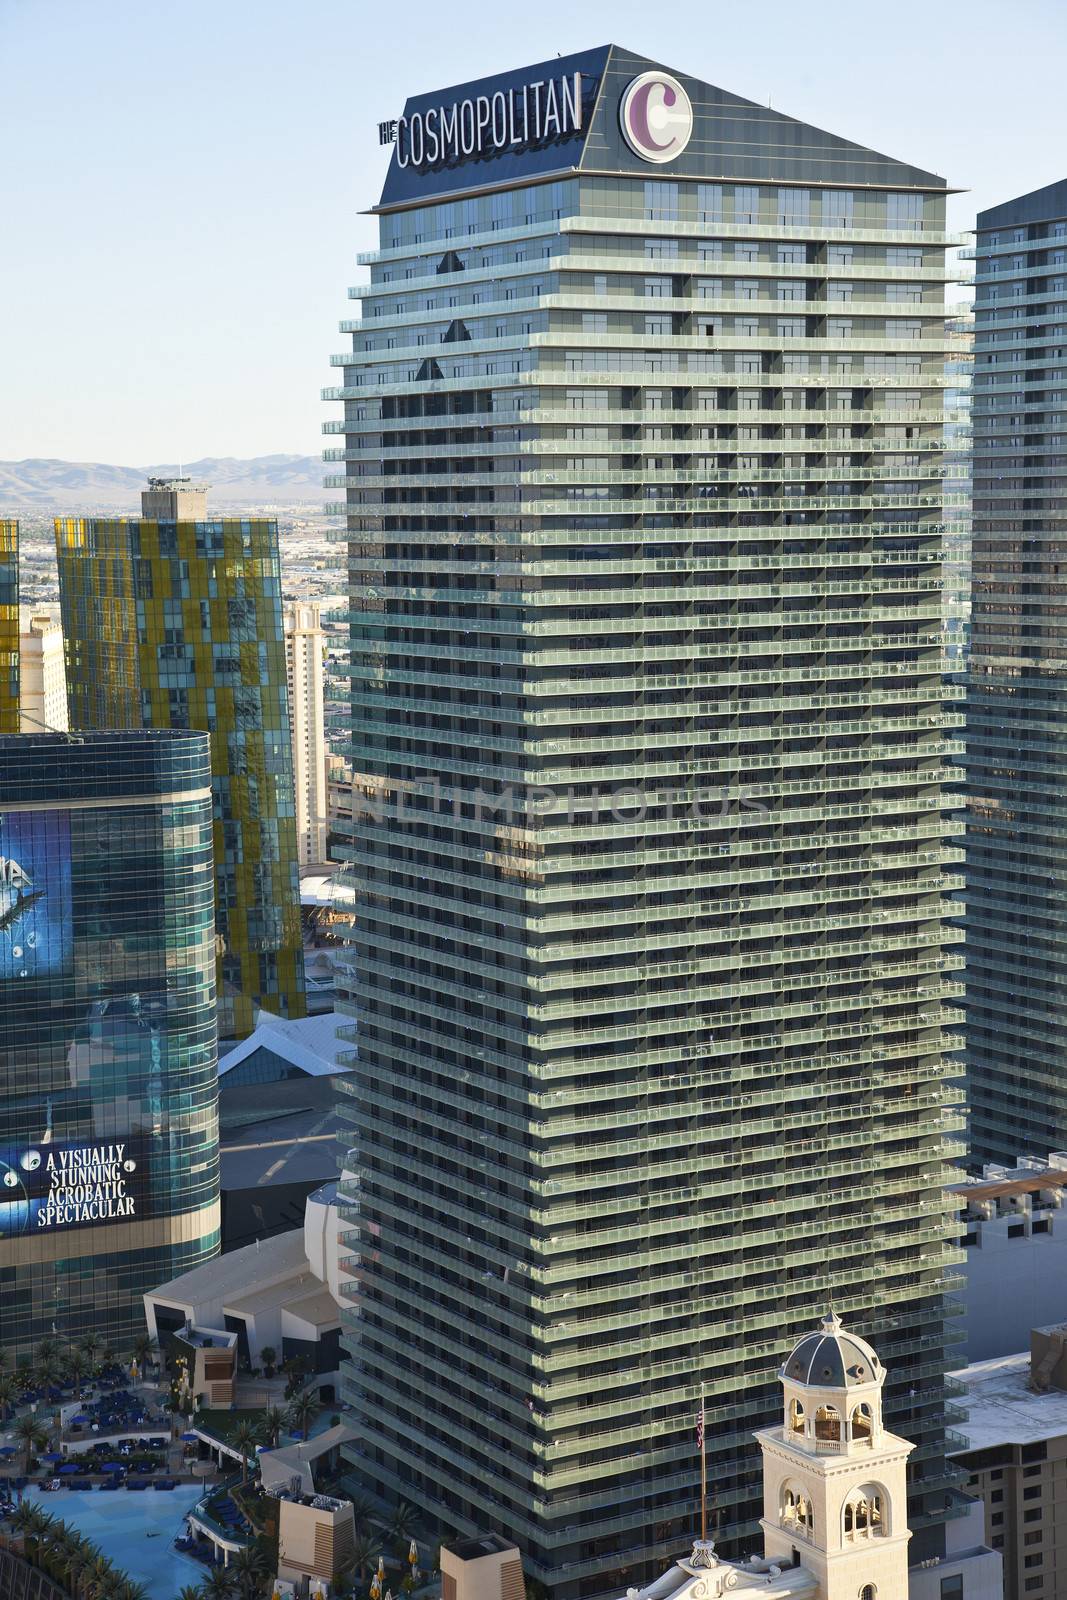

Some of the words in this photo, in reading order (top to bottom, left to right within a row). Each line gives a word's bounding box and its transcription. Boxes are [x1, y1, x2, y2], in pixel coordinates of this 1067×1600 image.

[377, 120, 398, 146] THE
[396, 72, 582, 169] COSMOPOLITAN
[629, 81, 677, 152] C
[46, 1152, 56, 1171] A
[59, 1144, 125, 1169] VISUALLY
[51, 1163, 121, 1189] STUNNING
[46, 1180, 126, 1208] ACROBATIC
[37, 1197, 136, 1227] SPECTACULAR
